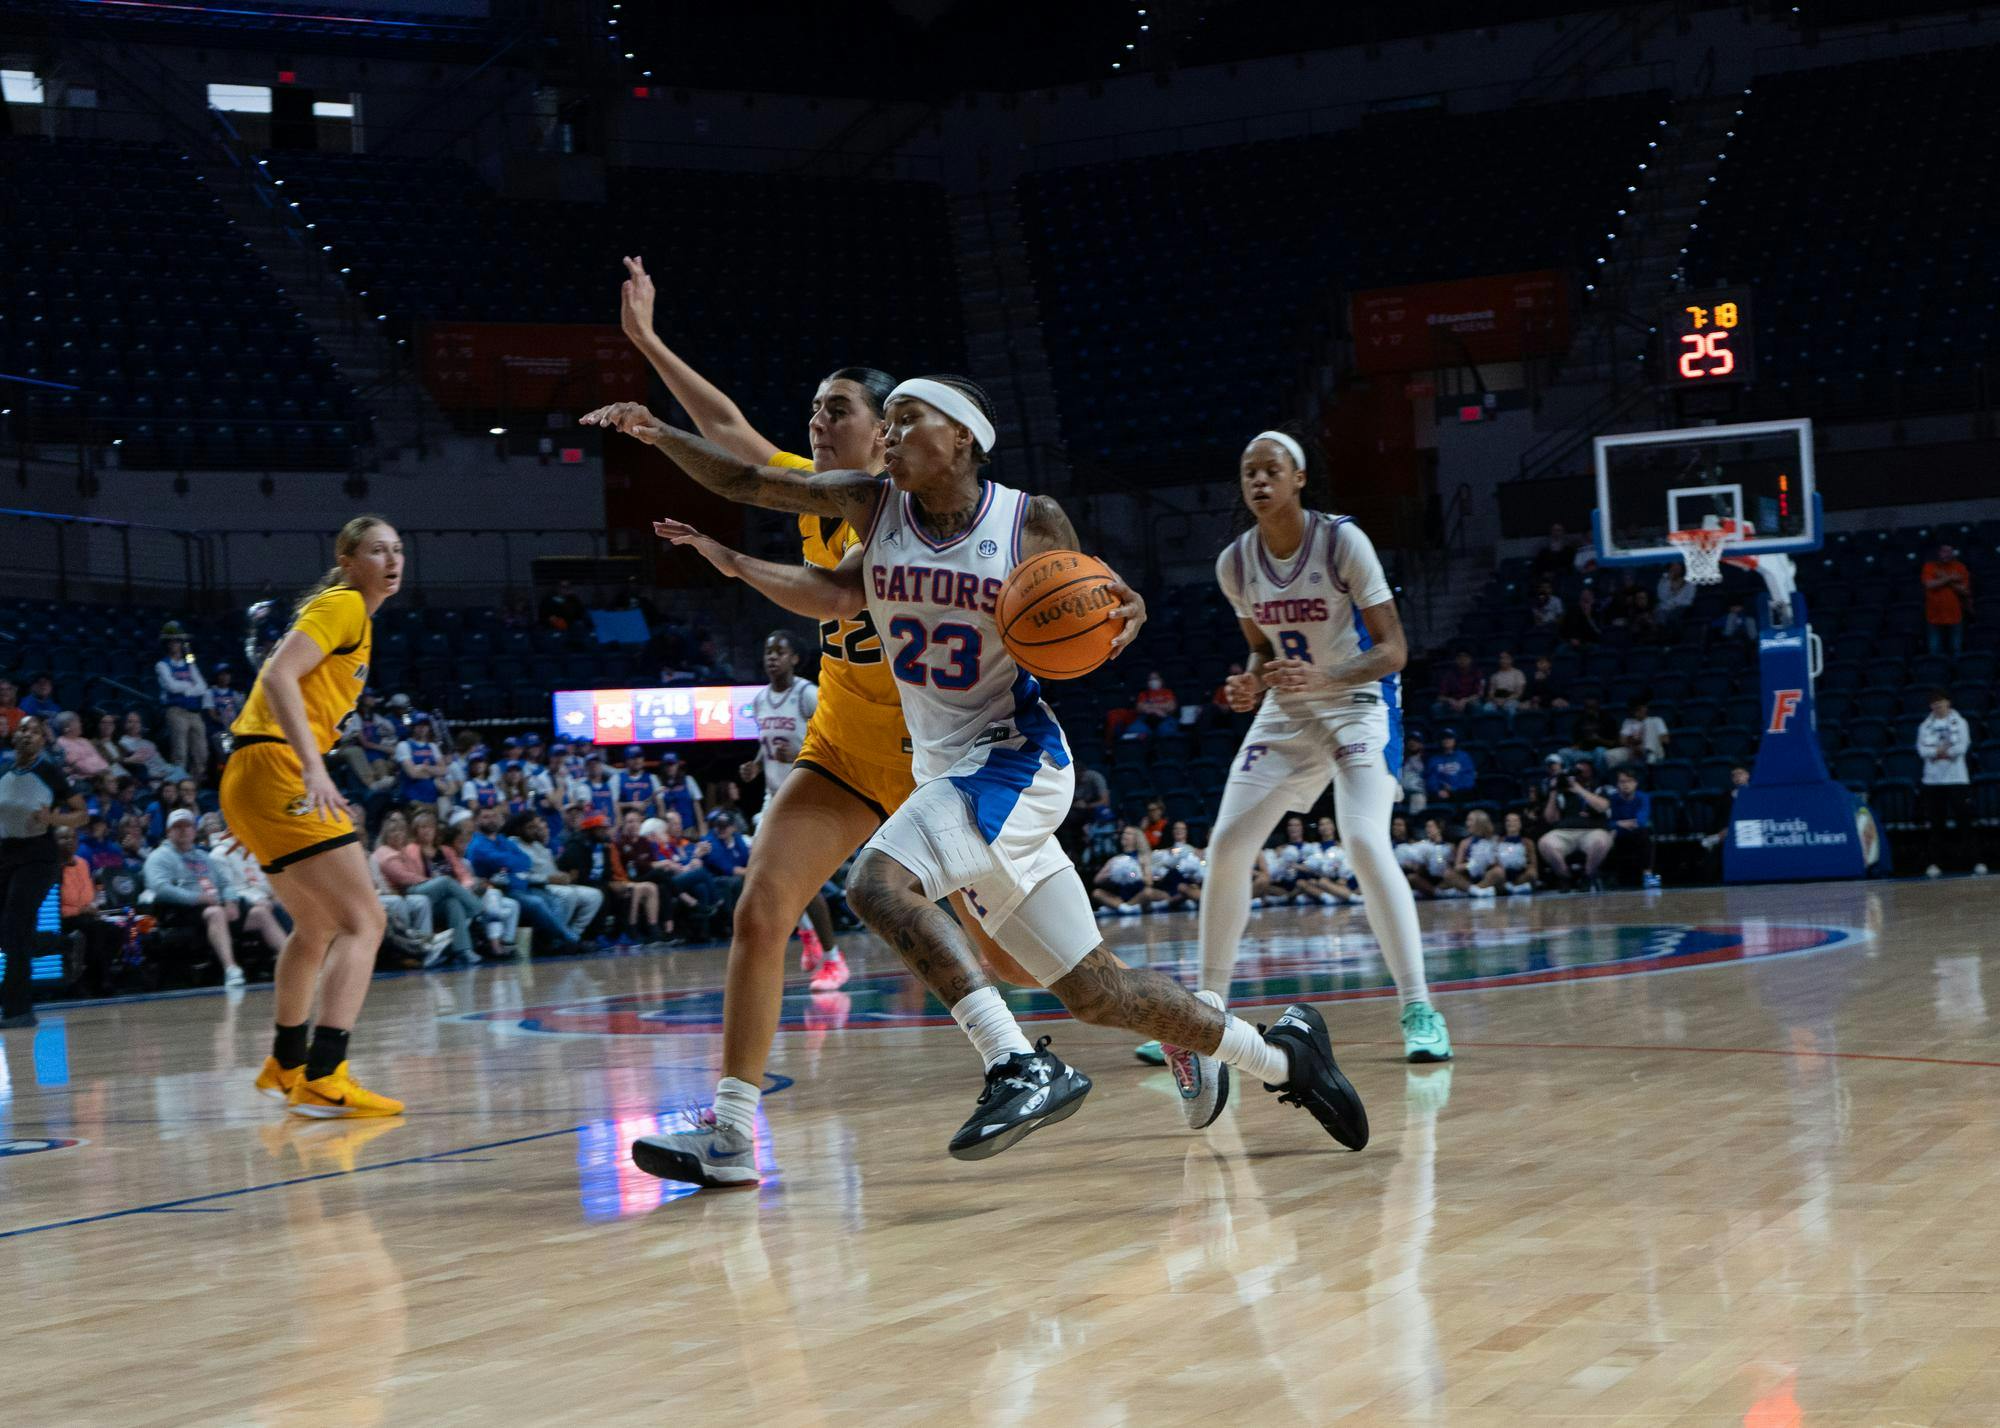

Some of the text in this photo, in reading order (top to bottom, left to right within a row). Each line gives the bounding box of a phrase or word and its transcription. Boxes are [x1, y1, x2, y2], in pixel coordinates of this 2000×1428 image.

[1685, 302, 1738, 329] 7:18
[1680, 331, 1734, 378] 25
[872, 565, 1003, 614] GATORS
[1033, 583, 1114, 628] Wilson
[819, 609, 884, 665] 22
[889, 615, 983, 691] 23
[698, 700, 731, 725] 74
[1767, 689, 1803, 734] F
[1240, 745, 1268, 772] F
